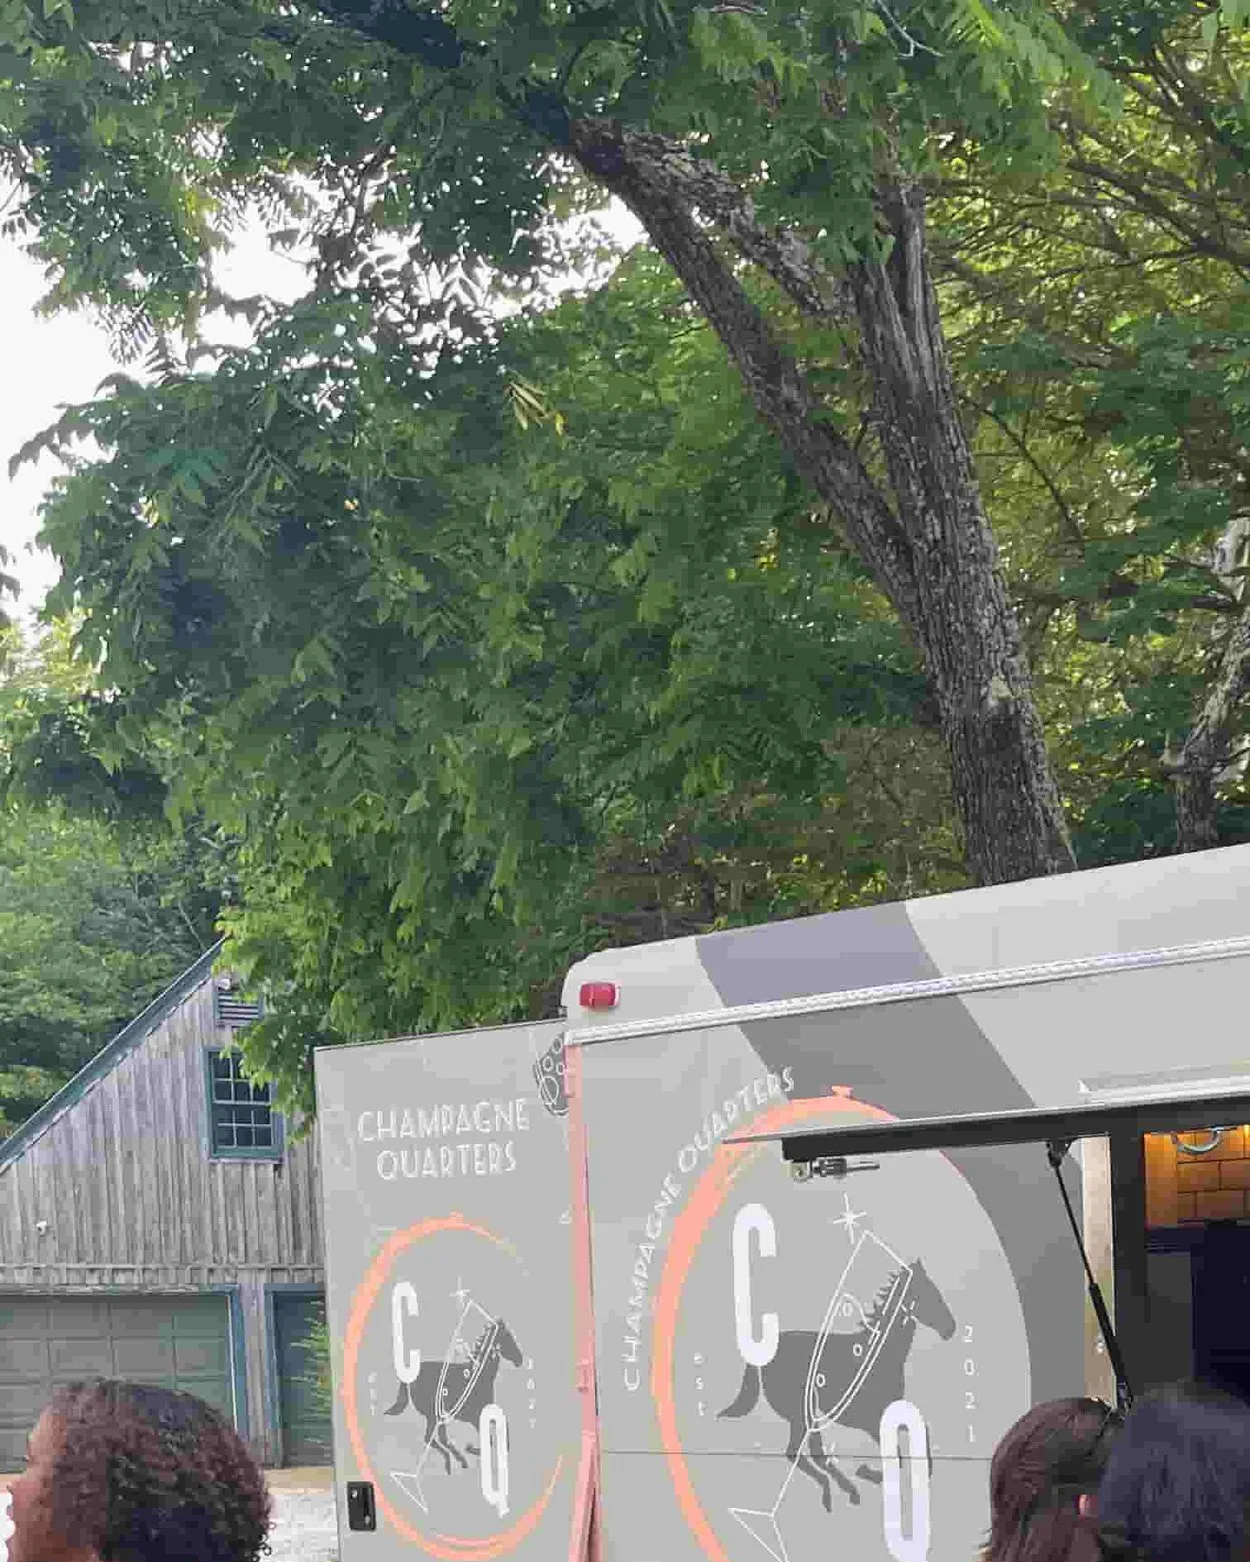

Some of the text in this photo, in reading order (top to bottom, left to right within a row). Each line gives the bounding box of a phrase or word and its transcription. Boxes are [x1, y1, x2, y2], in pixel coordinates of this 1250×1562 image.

[357, 1098, 530, 1142] CHAMPAGNE
[376, 1140, 517, 1181] QUARTERS
[622, 1065, 795, 1391] CHAMPAGNE QUARTERS
[392, 1281, 421, 1383] C
[732, 1203, 780, 1367] C
